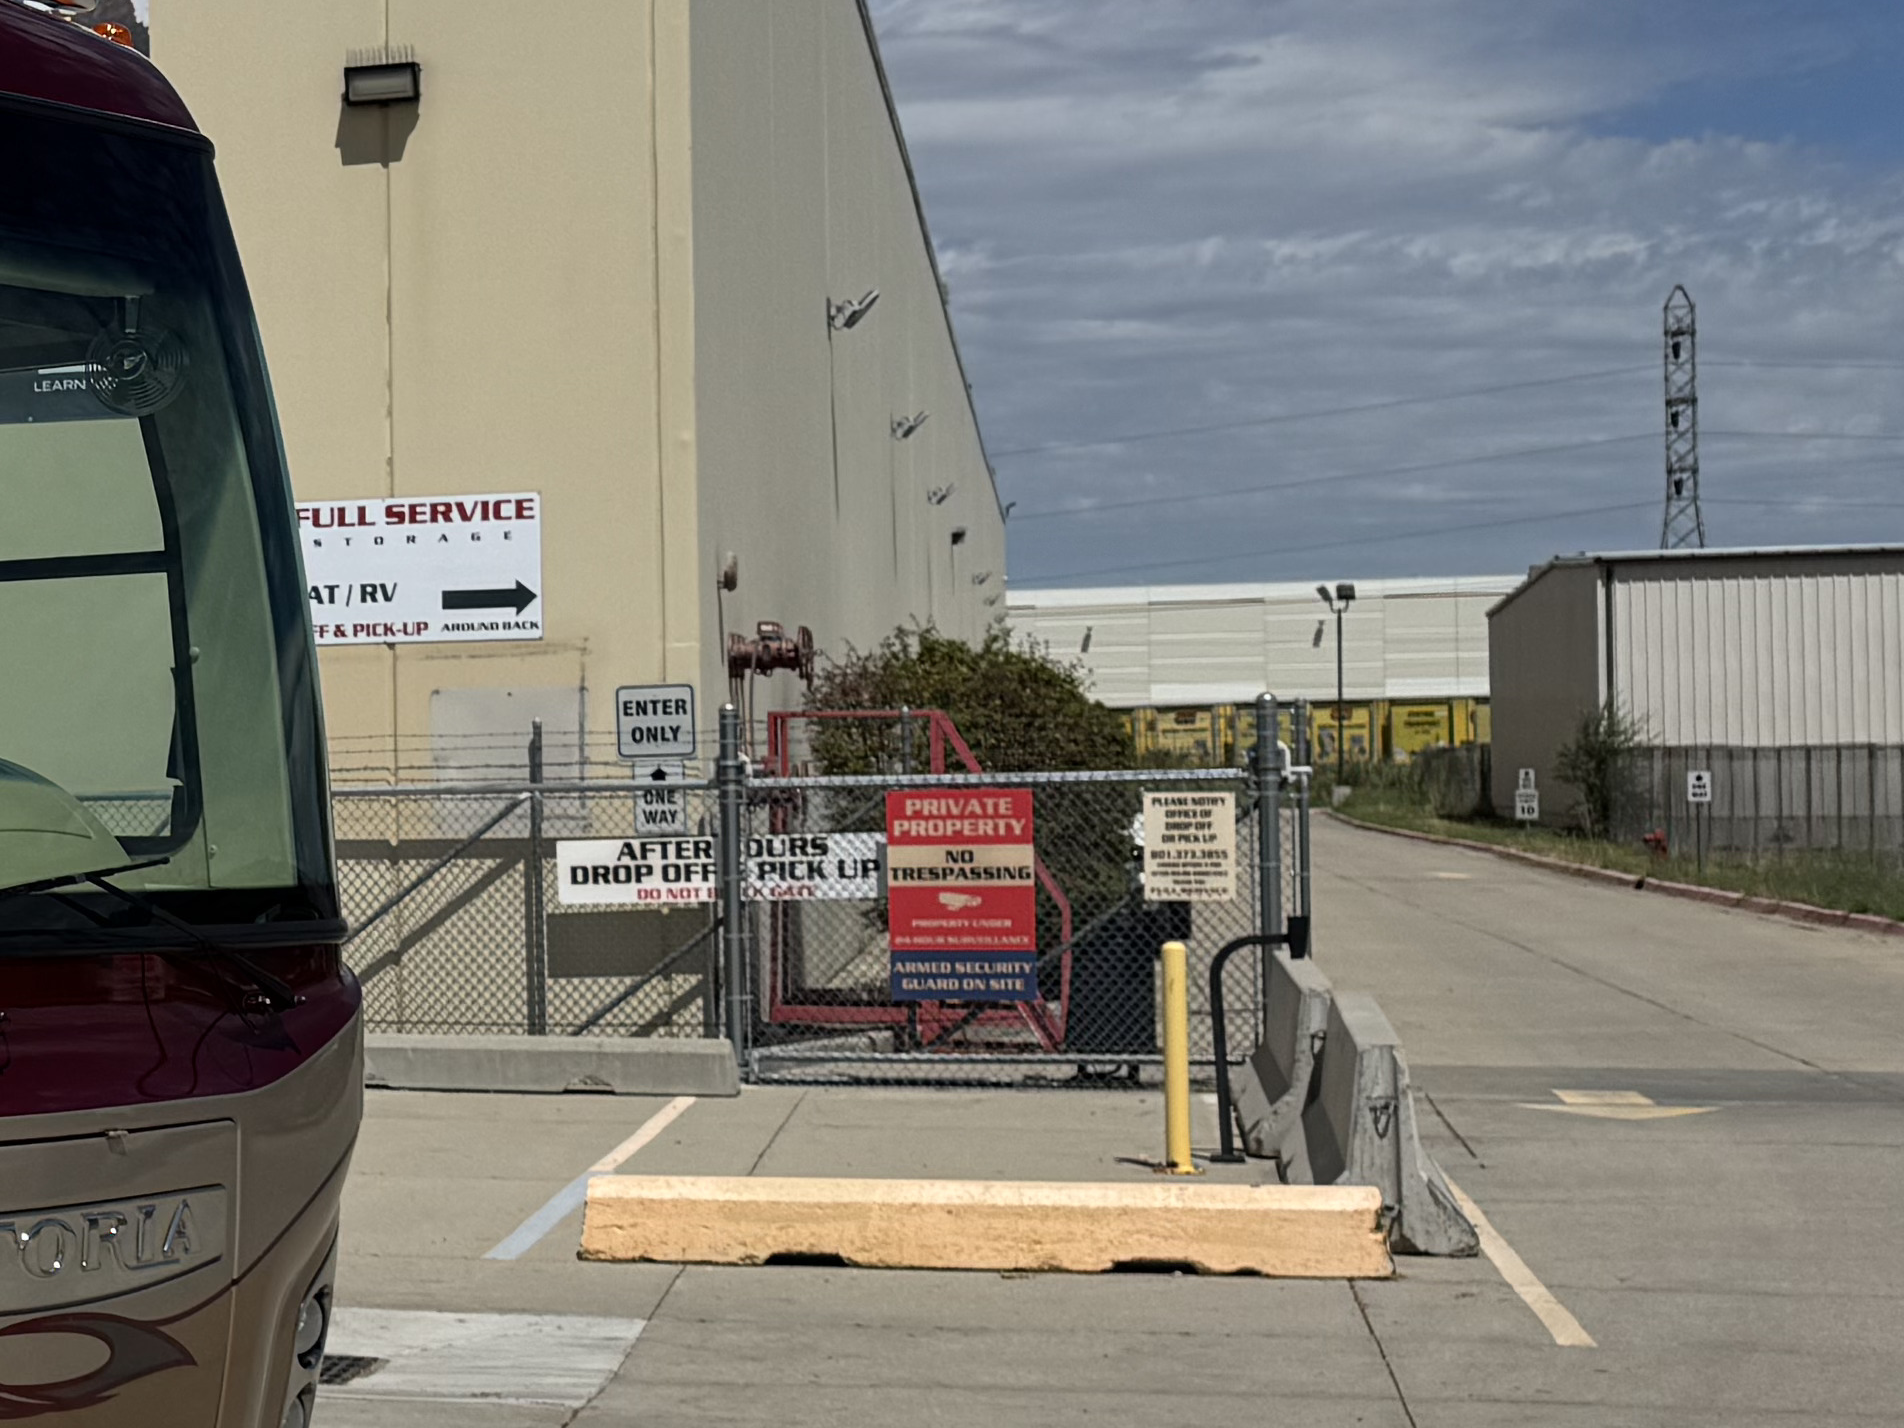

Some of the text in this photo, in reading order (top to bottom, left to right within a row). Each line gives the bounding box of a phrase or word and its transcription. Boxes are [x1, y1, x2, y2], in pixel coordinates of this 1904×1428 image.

[34, 379, 86, 392] LEARN
[296, 498, 535, 528] FULL SERVICE
[360, 582, 398, 604] RV
[333, 623, 348, 639] &
[352, 621, 429, 639] PICK-UP
[441, 620, 539, 632] AROUND BACK
[623, 699, 687, 716] ENTER
[631, 725, 681, 743] ONLY
[644, 788, 677, 805] ONE
[905, 797, 1013, 817] PRIVATE
[642, 808, 678, 825] WAY
[894, 818, 1026, 837] PROPERTY
[617, 836, 829, 861] AFTER OURS
[945, 849, 974, 864] NO
[570, 857, 881, 884] DROP OFF PICK UP
[891, 866, 1032, 881] TRESPASSING
[637, 887, 662, 900] DO
[667, 887, 702, 899] NOT
[894, 961, 1032, 974] ARMED SECURITY
[901, 978, 1025, 990] GUARD ON SITE
